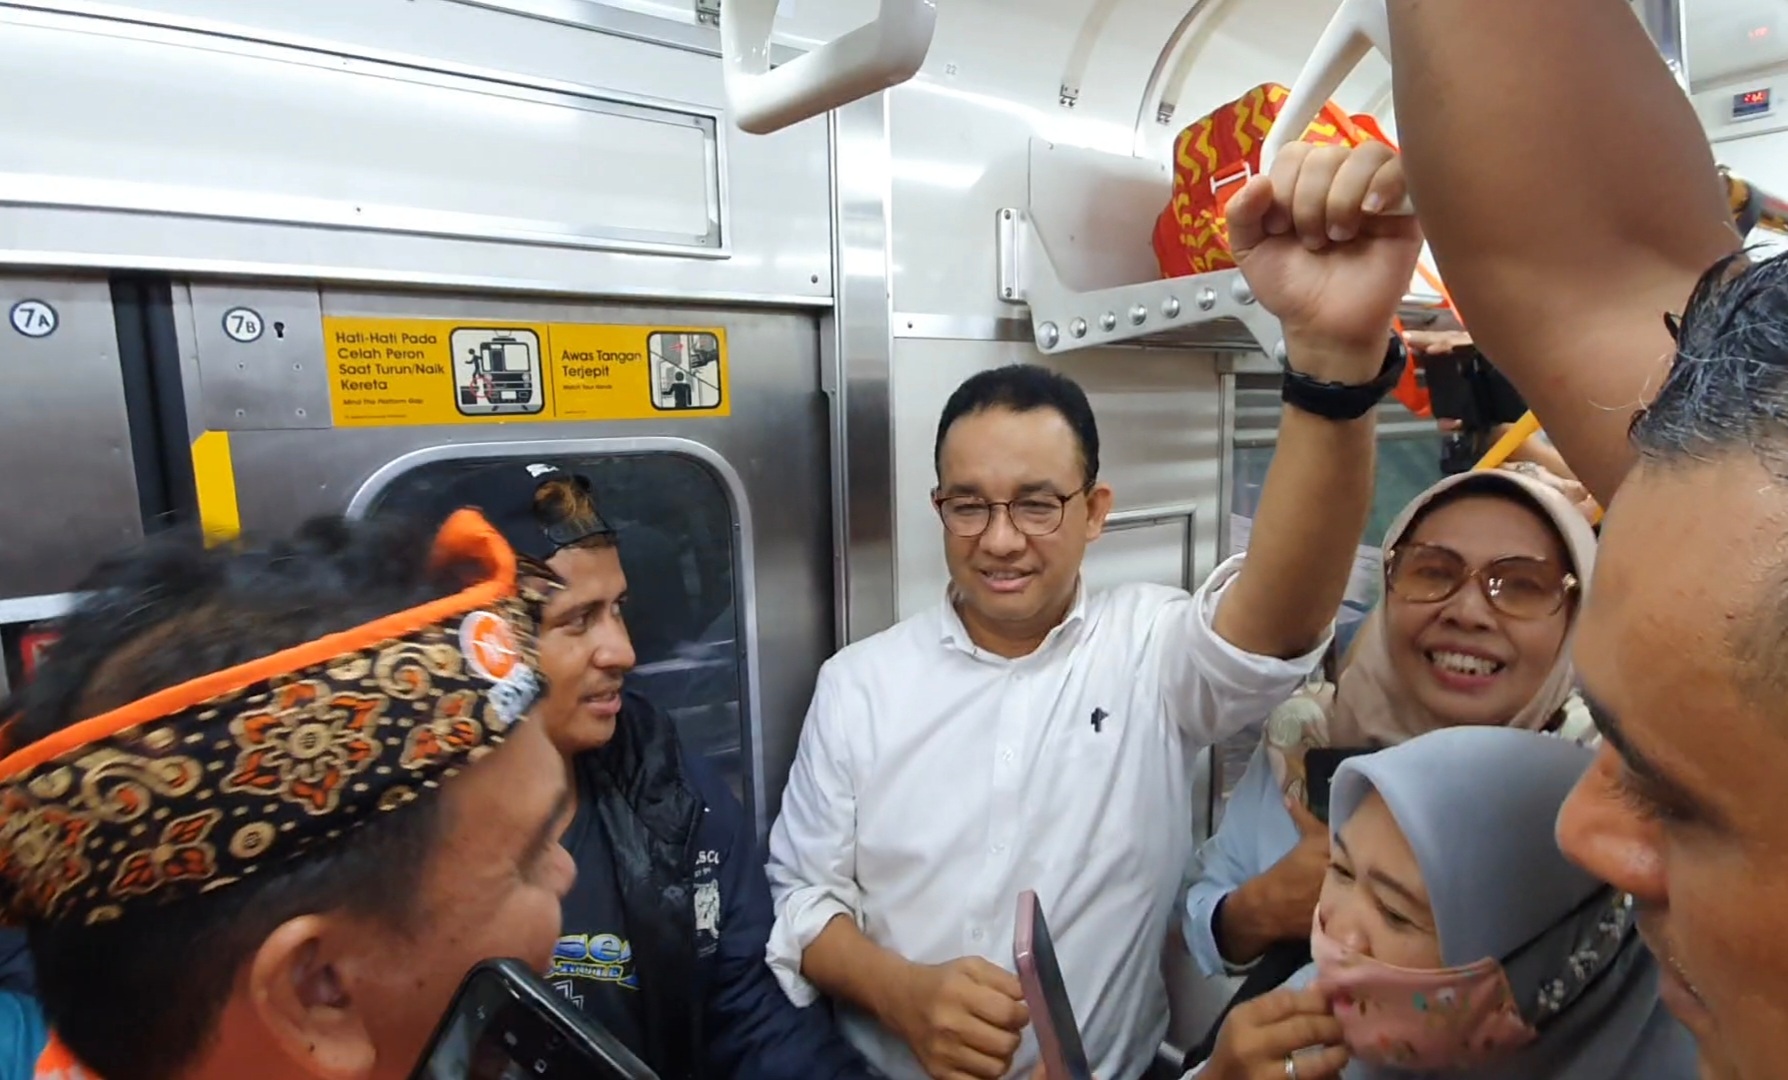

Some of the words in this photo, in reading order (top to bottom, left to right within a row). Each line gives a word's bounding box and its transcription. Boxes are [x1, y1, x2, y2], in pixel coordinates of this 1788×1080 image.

[19, 308, 51, 328] 7A
[230, 315, 257, 334] 7B
[335, 331, 398, 344] Hati-Hati
[401, 332, 437, 344] Pada
[337, 347, 382, 360] Celah
[386, 348, 425, 360] Peron
[561, 349, 594, 361] Awas
[596, 349, 642, 364] Tangan
[339, 363, 372, 375] Saat
[375, 363, 445, 375] Turun/Naik
[562, 365, 610, 379] Terjepit
[340, 379, 388, 391] Kereta
